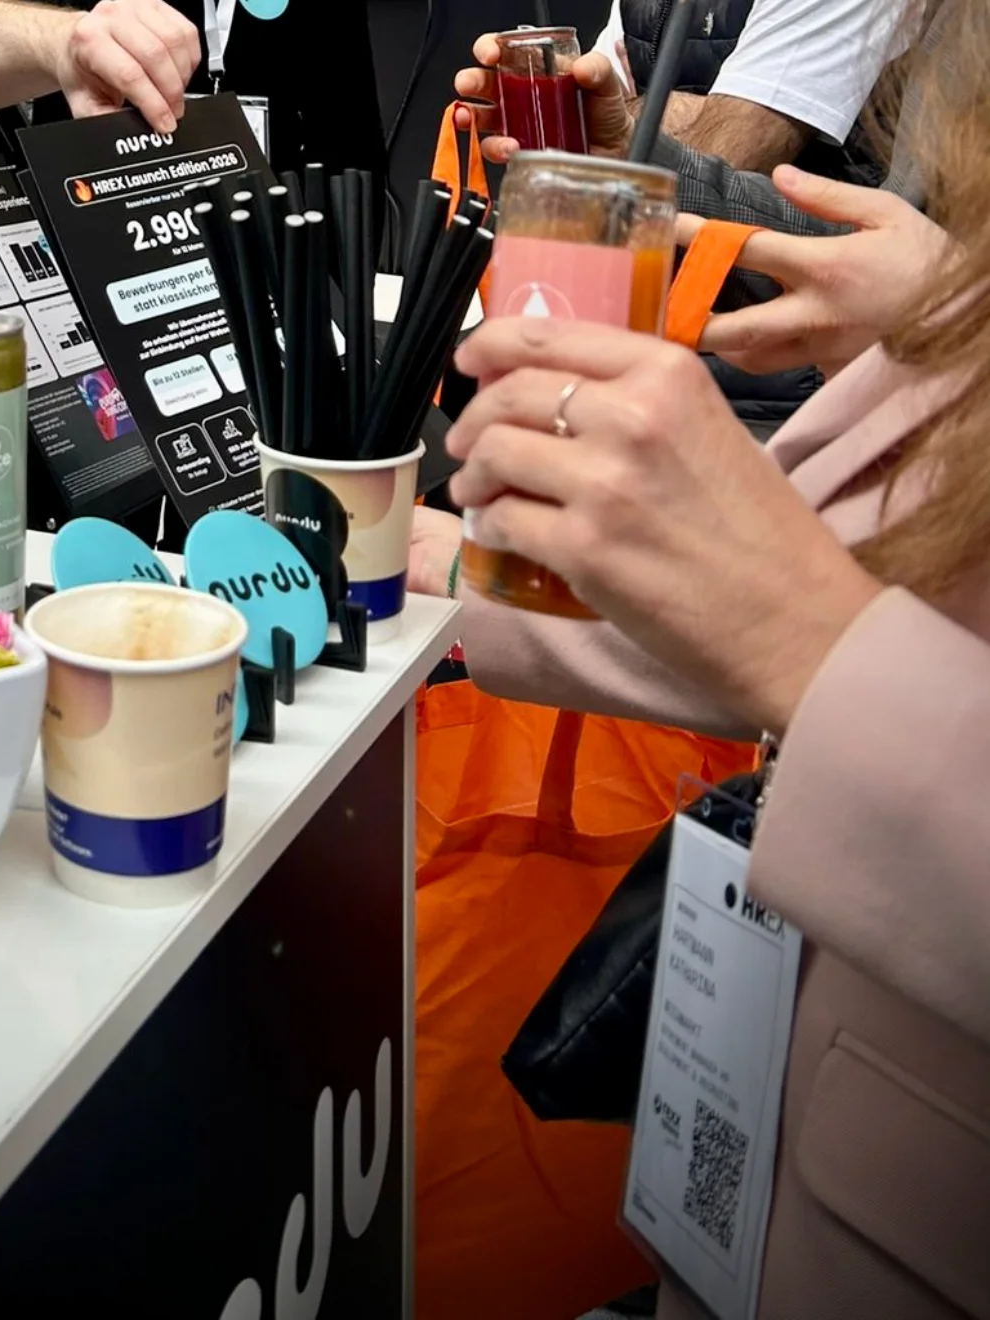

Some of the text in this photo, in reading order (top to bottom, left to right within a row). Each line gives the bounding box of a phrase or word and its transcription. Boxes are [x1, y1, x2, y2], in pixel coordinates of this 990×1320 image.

[92, 152, 239, 196] HREX Launch Edition 2026
[117, 269, 205, 301] Bewerbungen per
[133, 296, 159, 313] statt
[209, 561, 311, 605] nurdu
